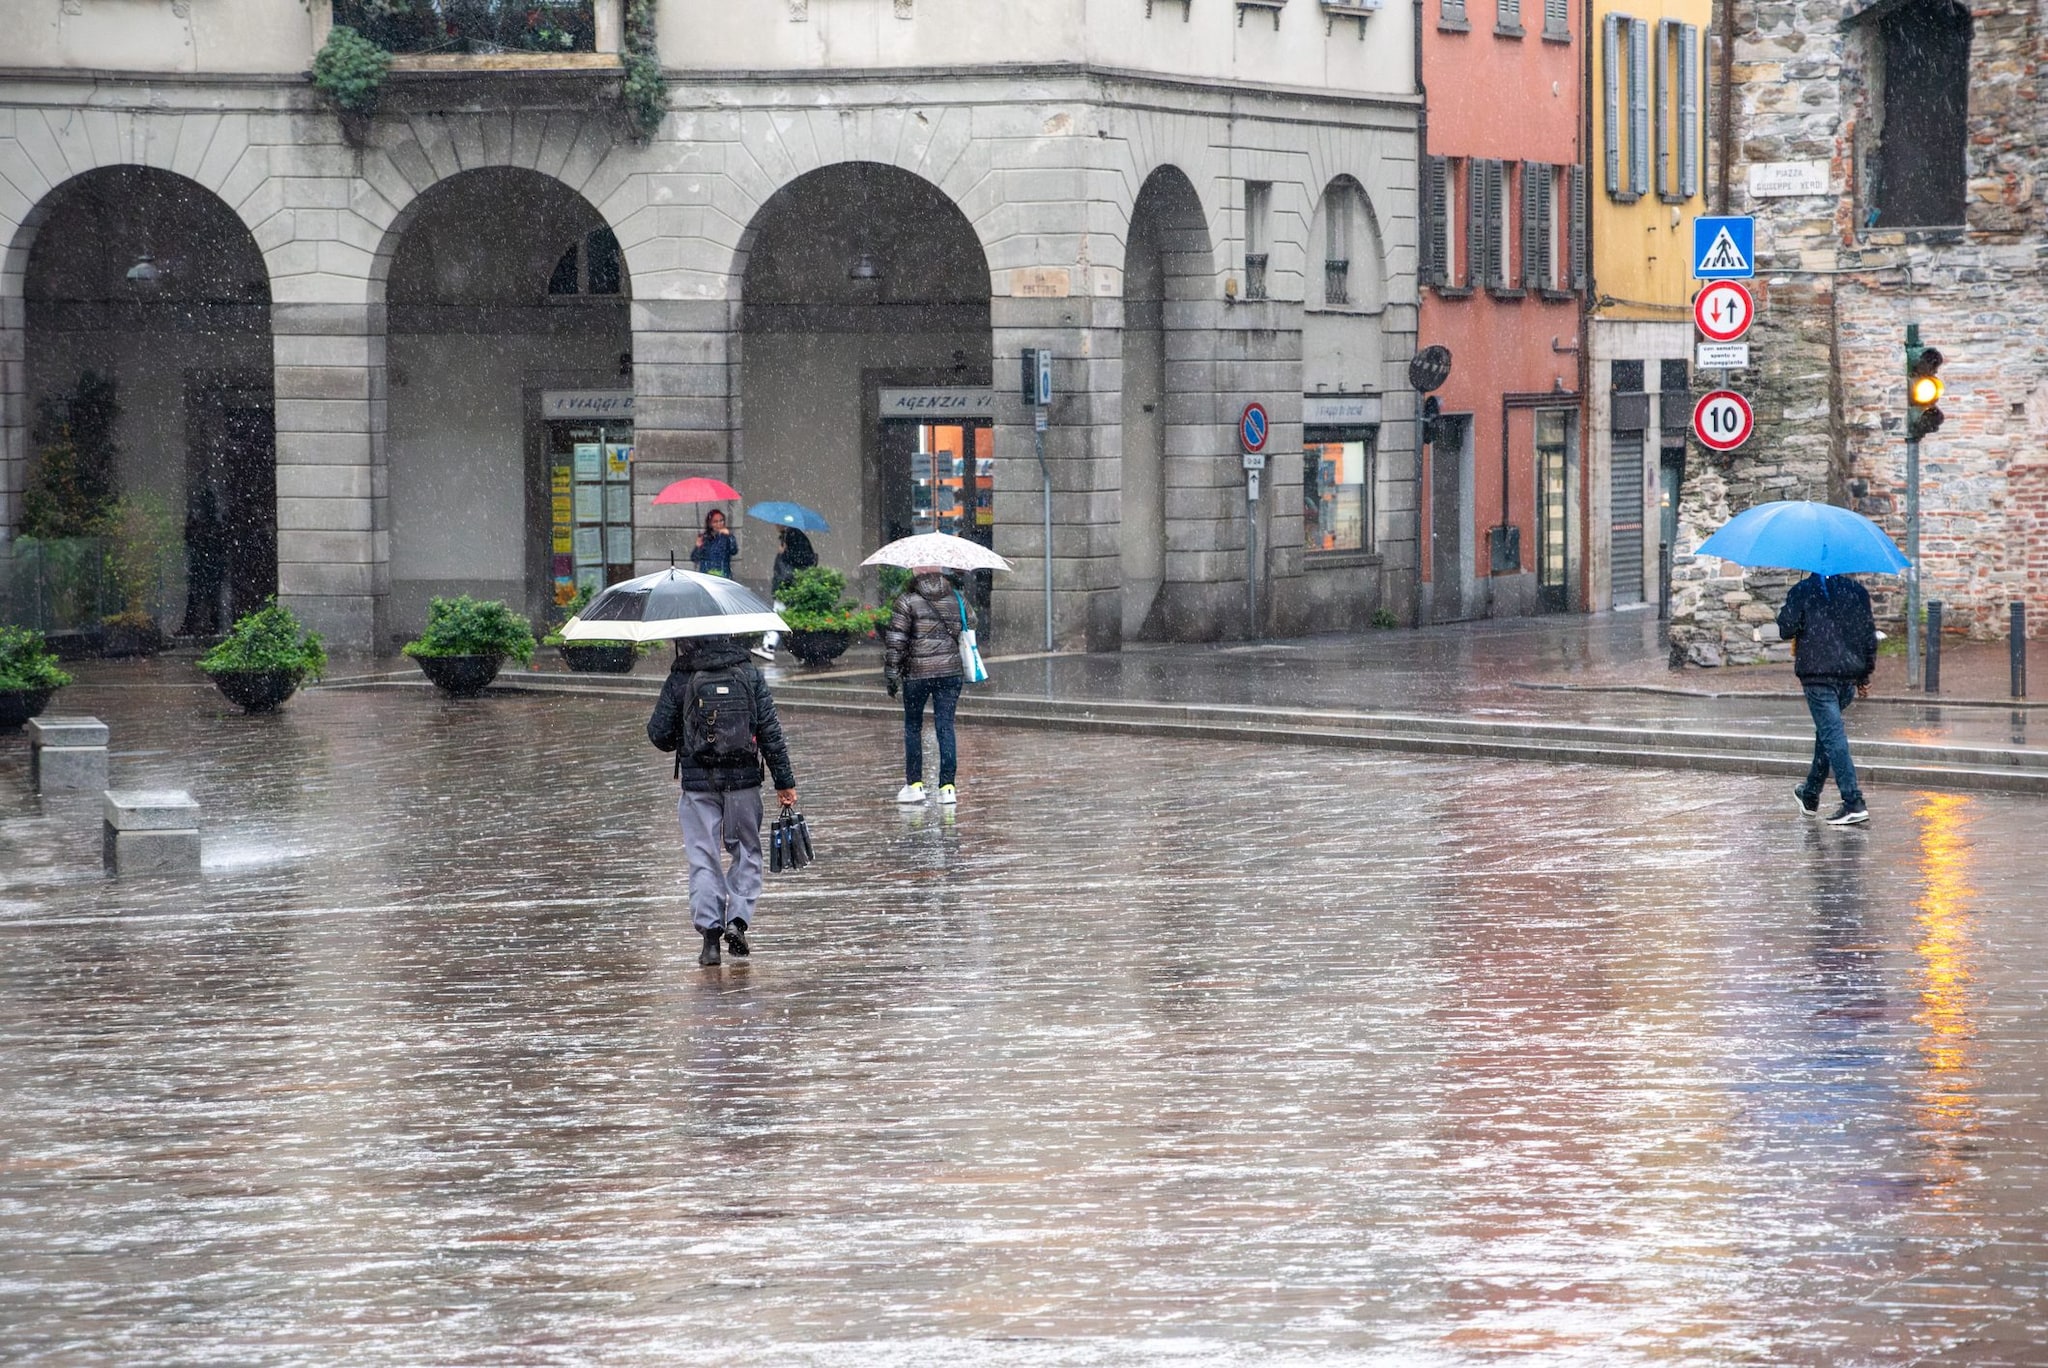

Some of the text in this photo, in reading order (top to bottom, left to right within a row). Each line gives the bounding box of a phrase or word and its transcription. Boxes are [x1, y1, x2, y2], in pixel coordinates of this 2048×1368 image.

[1775, 169, 1803, 177] PIAZZA
[1800, 180, 1823, 190] VERDI
[569, 398, 618, 411] VIAGGI
[895, 396, 966, 410] AGENZIA
[1710, 406, 1738, 433] 10
